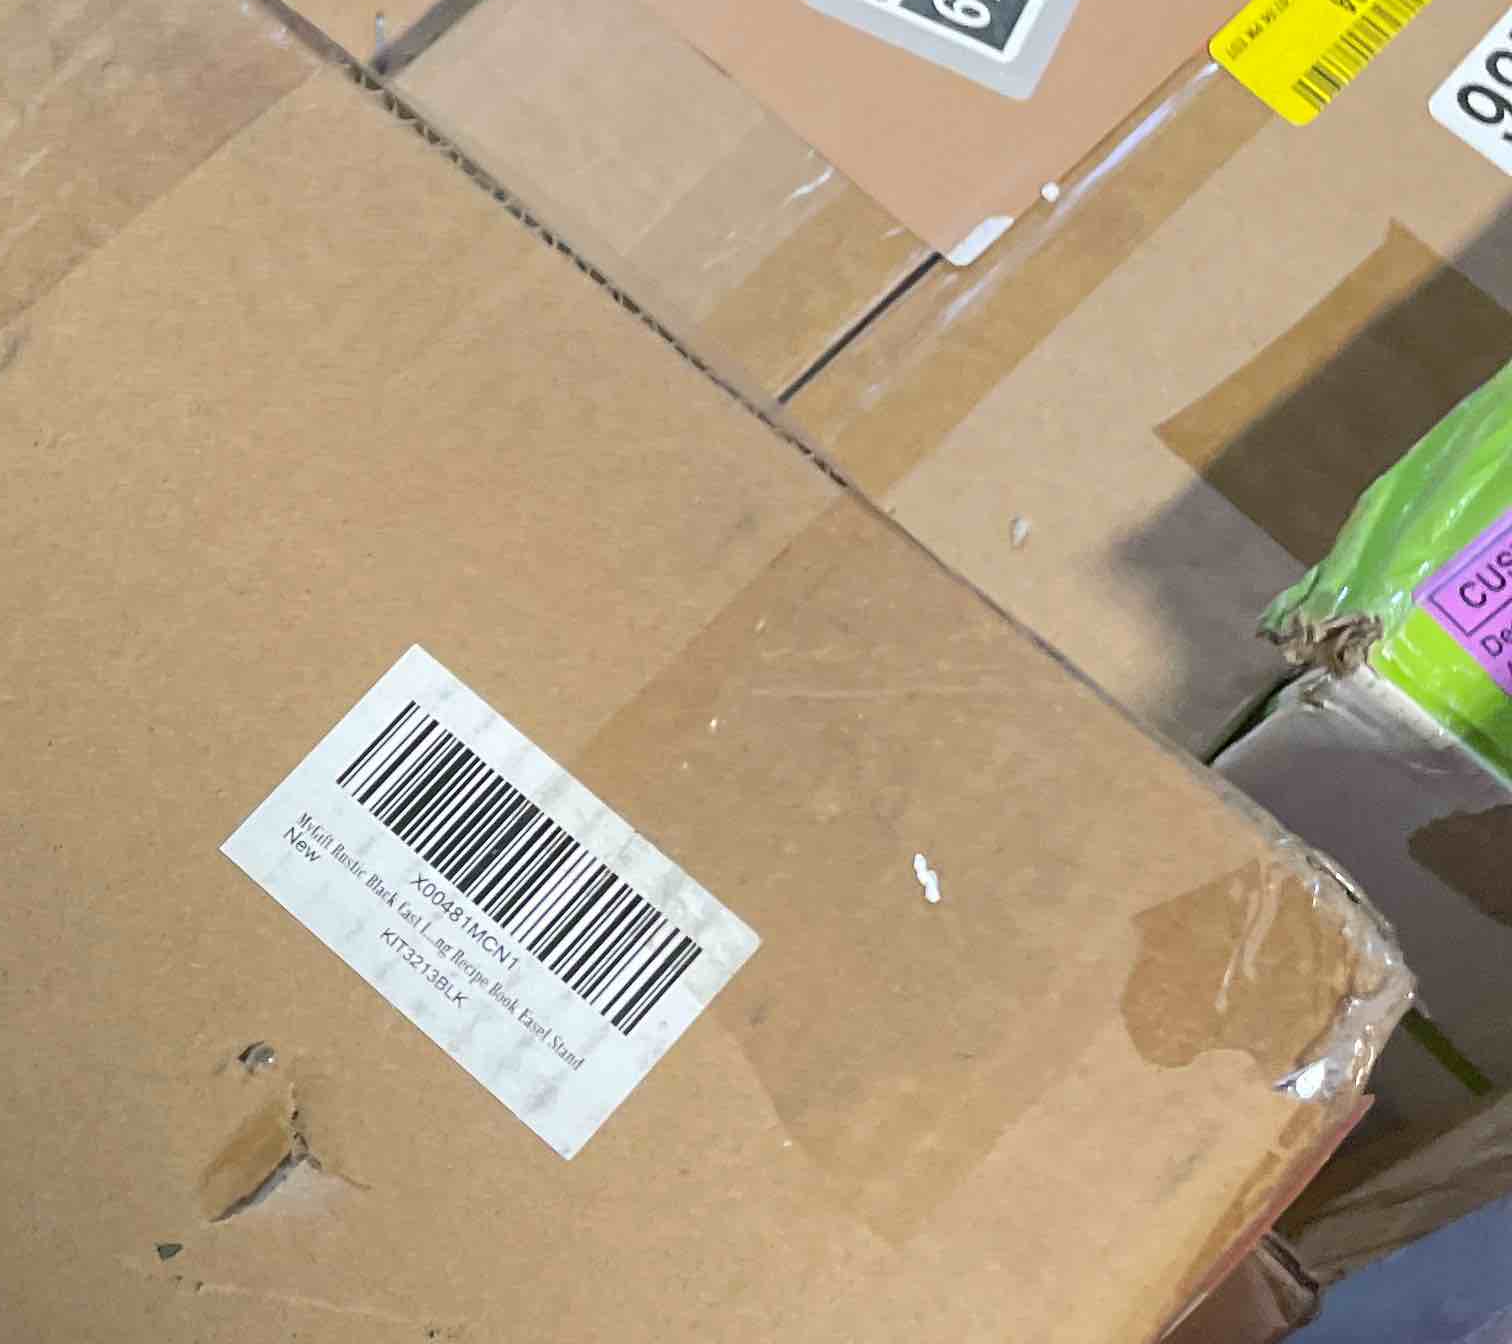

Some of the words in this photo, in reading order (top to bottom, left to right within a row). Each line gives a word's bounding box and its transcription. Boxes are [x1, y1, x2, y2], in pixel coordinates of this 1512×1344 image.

[281, 825, 323, 864] New
[329, 842, 368, 879] Rustic
[363, 873, 400, 907] Black
[394, 900, 424, 929] Cast
[446, 949, 492, 992] Recipe
[486, 982, 520, 1013] Book
[515, 1007, 552, 1042] Easel
[545, 1035, 585, 1071] Stand
[376, 925, 470, 1008] KIT3213BLK
[408, 871, 520, 972] X00481MCN1
